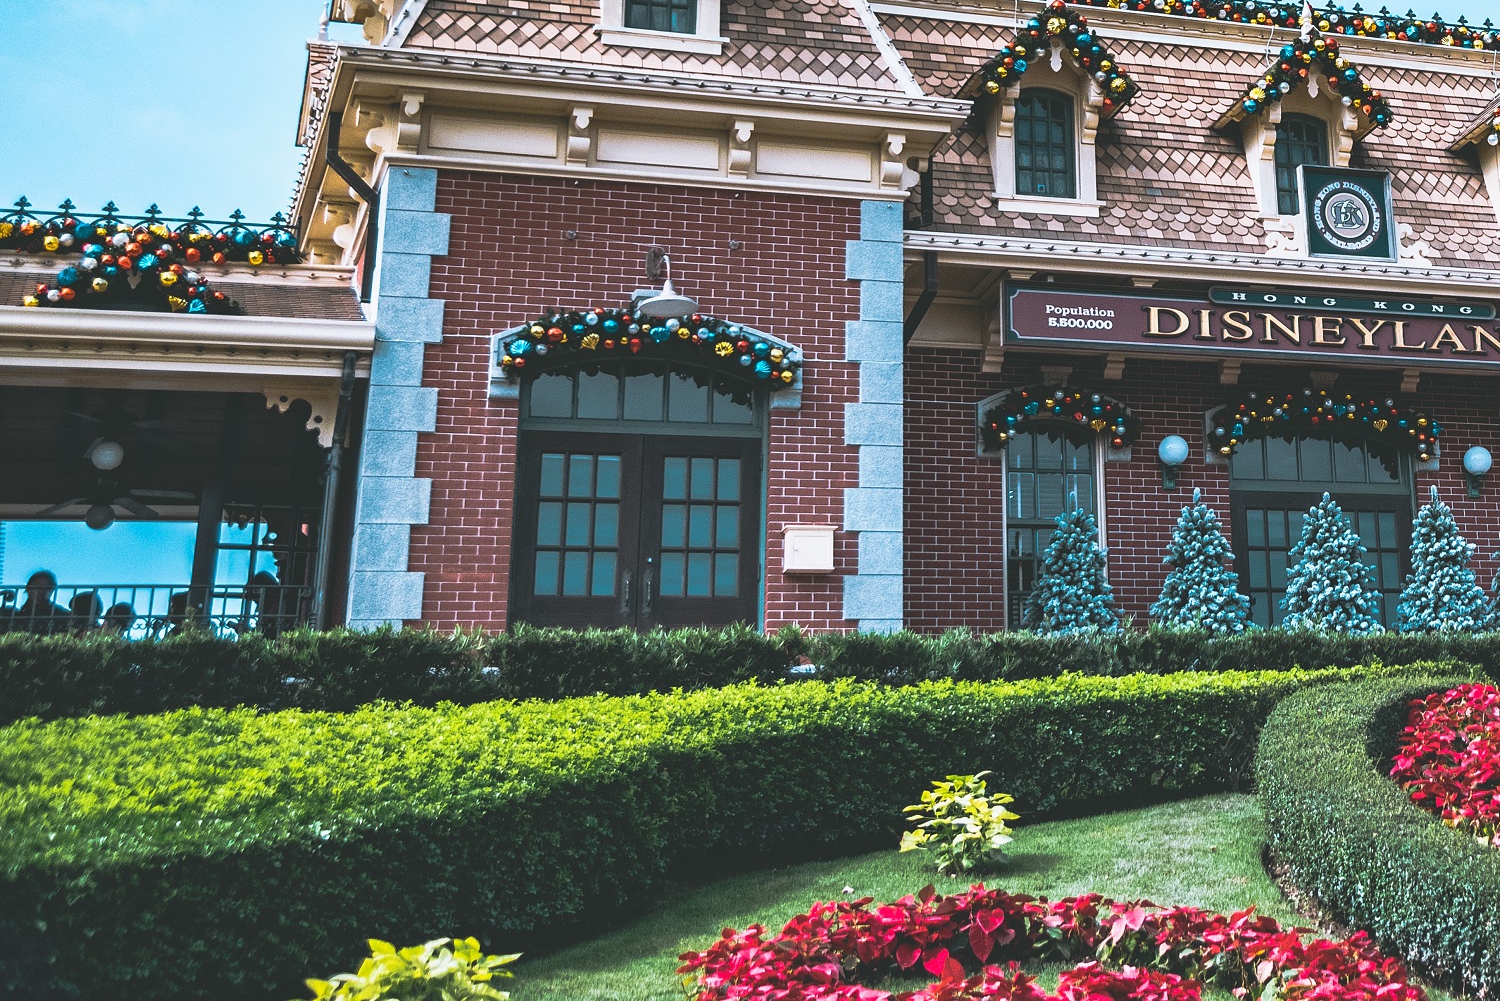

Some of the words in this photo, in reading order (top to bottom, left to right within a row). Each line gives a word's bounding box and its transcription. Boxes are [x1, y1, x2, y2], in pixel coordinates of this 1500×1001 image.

[1231, 292, 1337, 306] HONG
[1373, 301, 1473, 315] KONG
[1045, 304, 1115, 317] Population
[1048, 317, 1113, 329] 5,500,000
